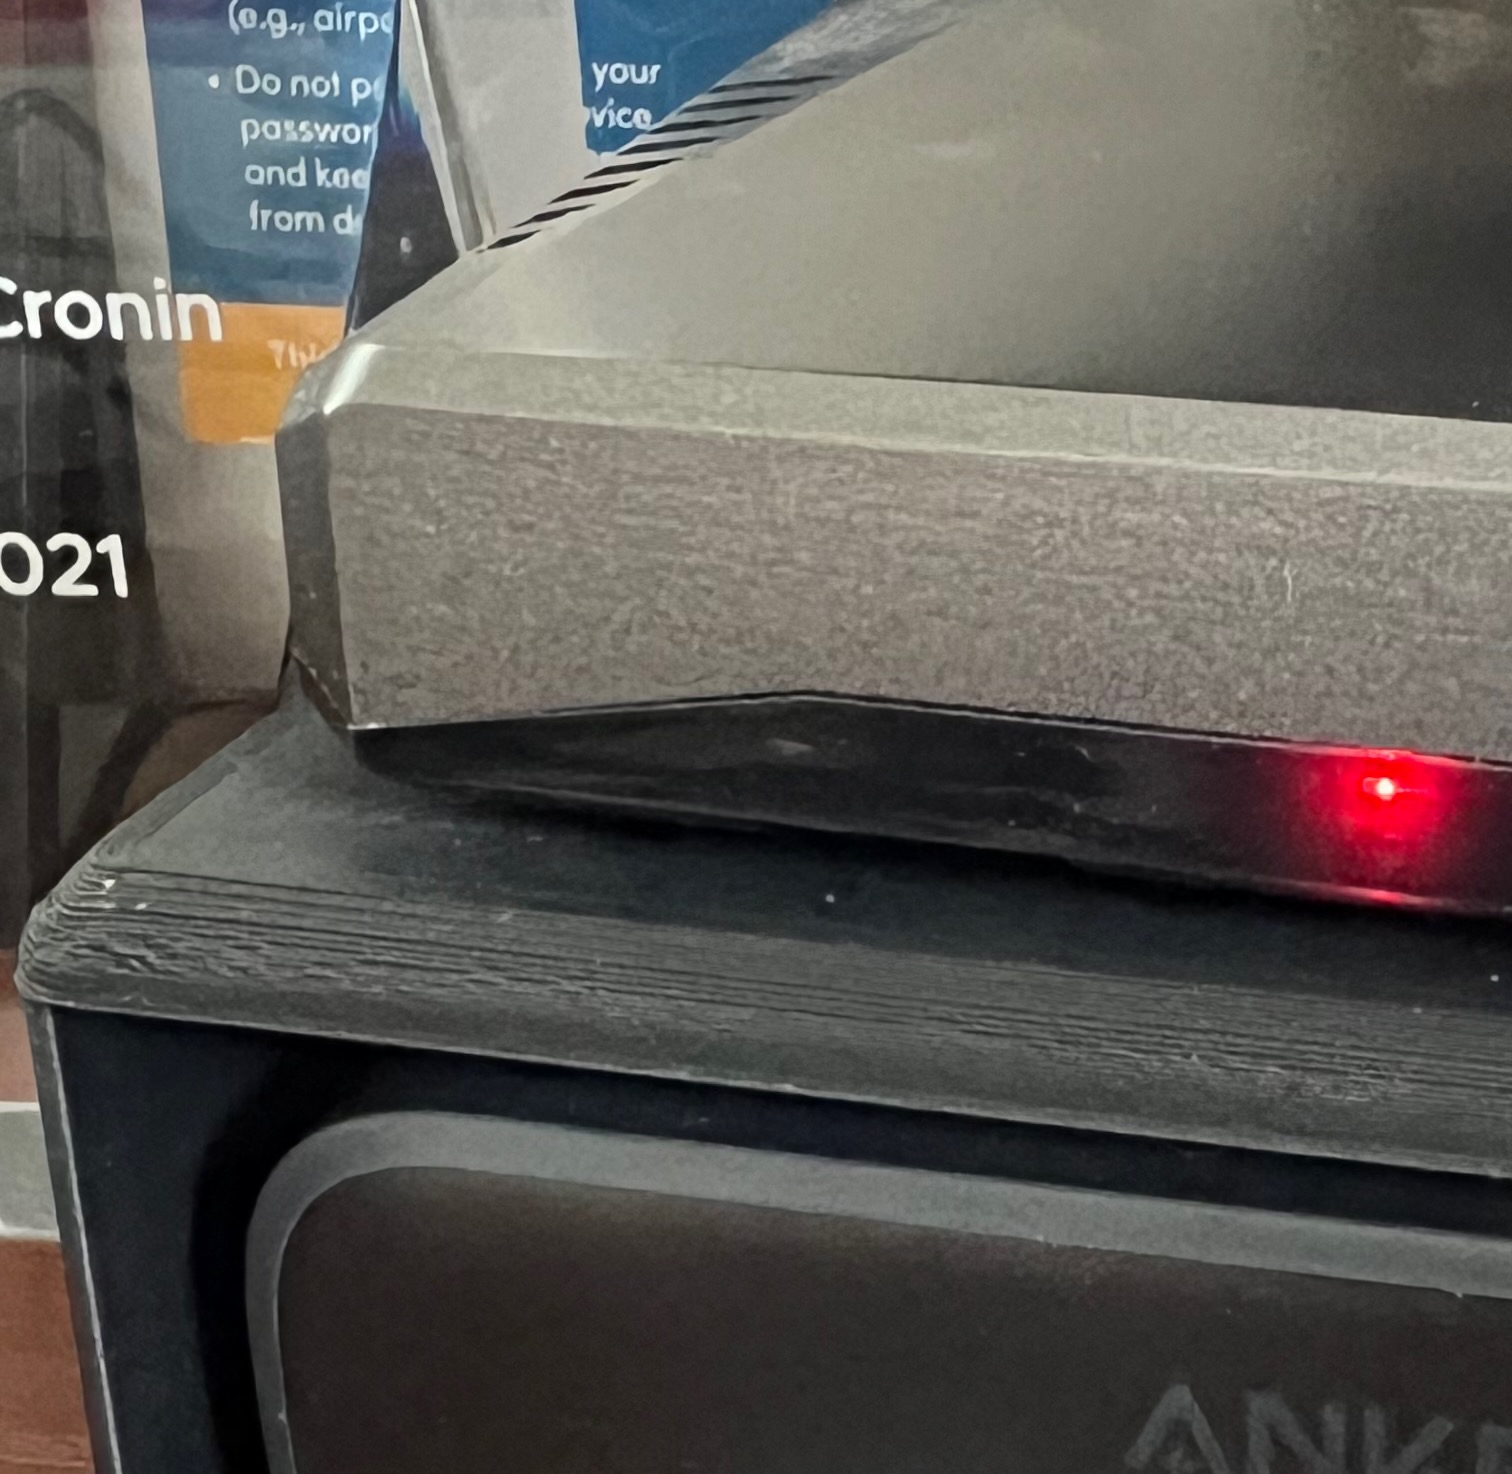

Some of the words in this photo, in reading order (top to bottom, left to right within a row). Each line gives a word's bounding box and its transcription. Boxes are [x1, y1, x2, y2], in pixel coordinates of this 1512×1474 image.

[235, 64, 282, 95] Do
[290, 70, 340, 98] not
[591, 62, 661, 92] your
[244, 156, 307, 187] and
[249, 199, 325, 232] from
[0, 532, 128, 598] 021
